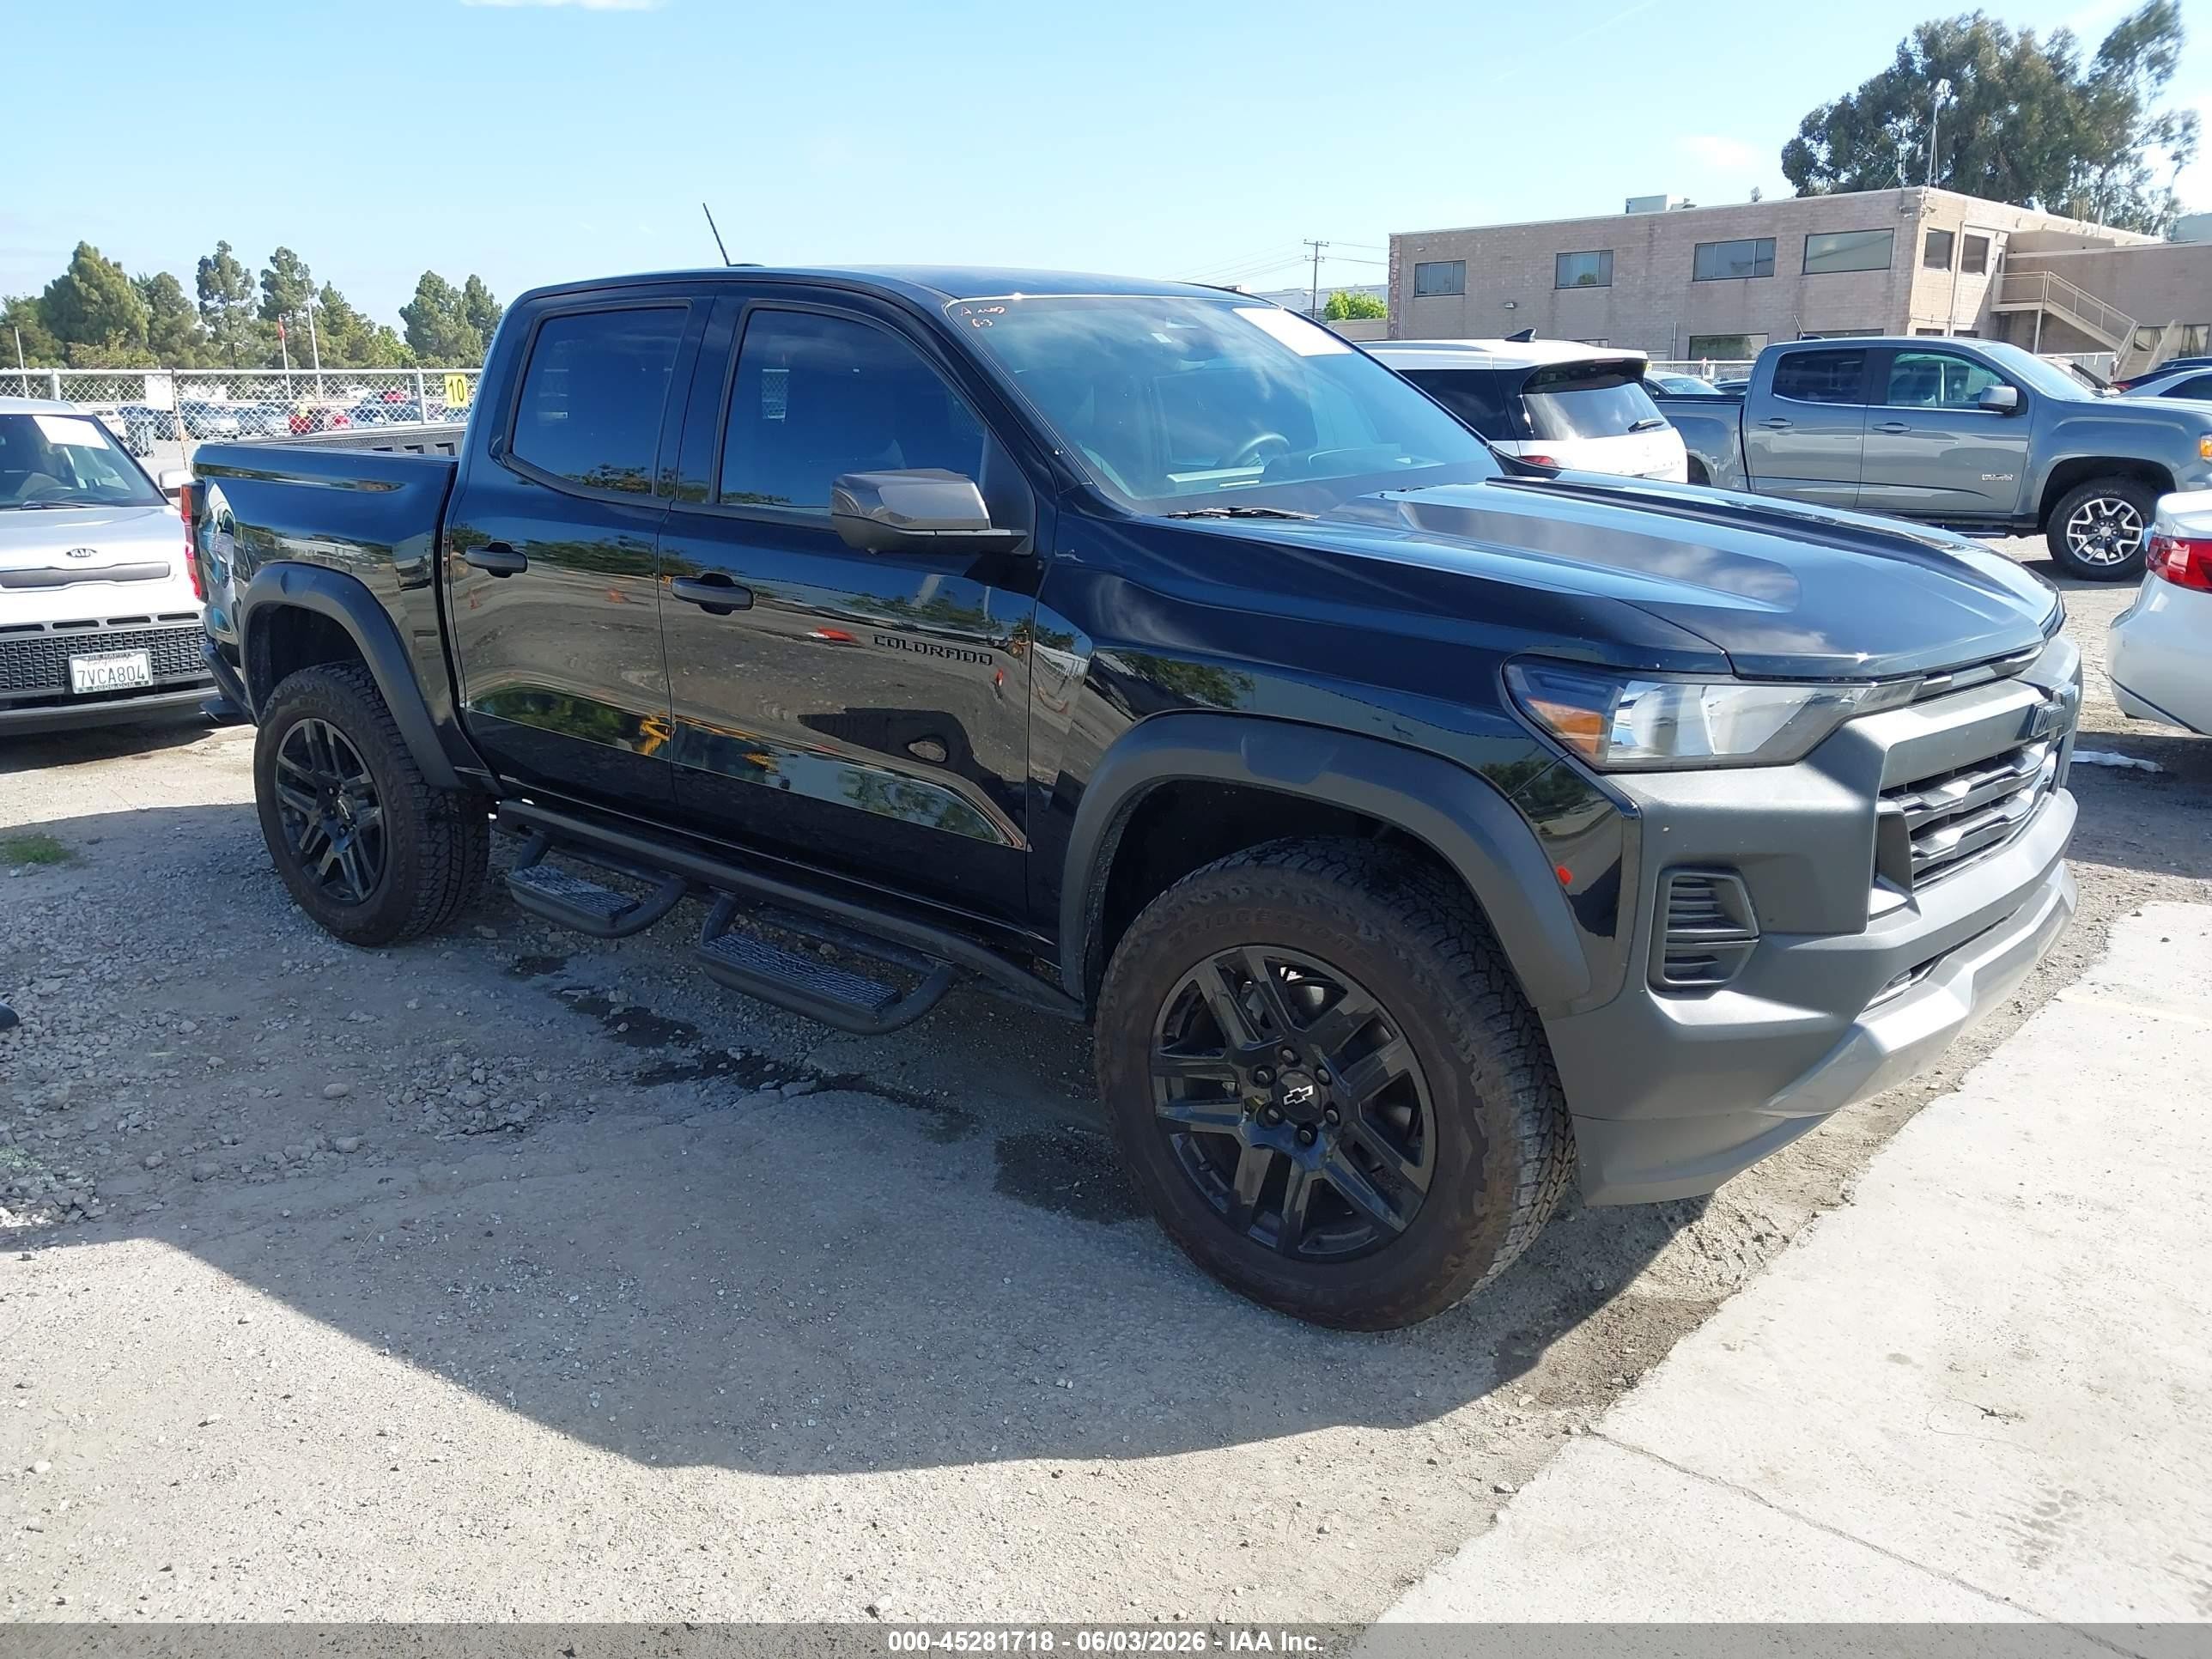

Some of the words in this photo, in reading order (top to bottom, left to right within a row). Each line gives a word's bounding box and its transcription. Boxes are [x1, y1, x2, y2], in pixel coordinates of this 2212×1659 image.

[448, 378, 465, 403] 10
[872, 634, 994, 666] COLORADO
[76, 664, 145, 687] 7VCA804
